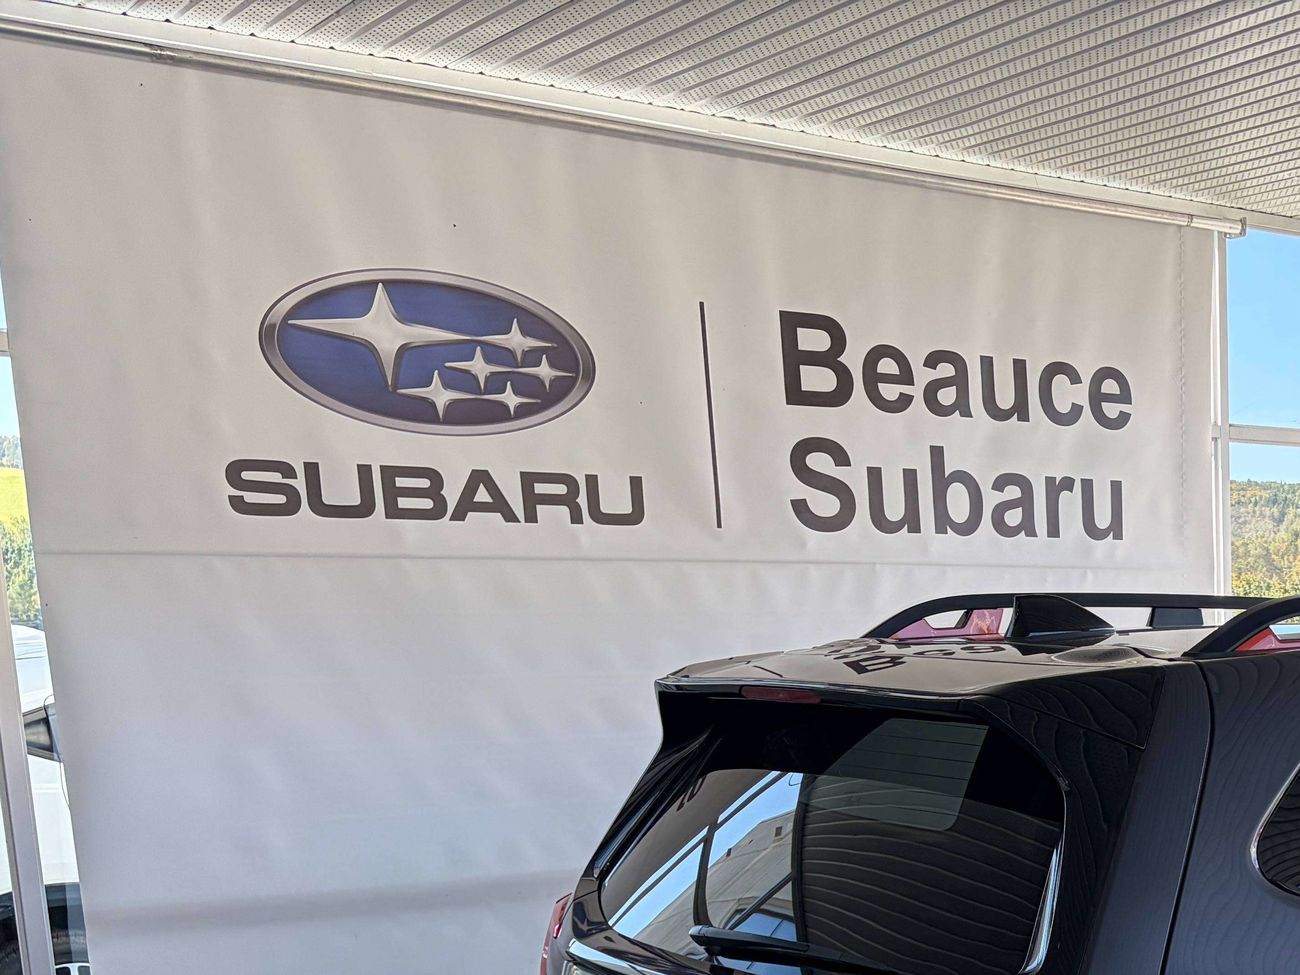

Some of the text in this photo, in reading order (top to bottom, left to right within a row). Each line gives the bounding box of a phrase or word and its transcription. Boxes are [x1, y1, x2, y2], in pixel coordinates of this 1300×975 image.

[778, 310, 1133, 431] Beauce
[225, 459, 645, 526] SUBARU
[788, 437, 1124, 541] Subaru
